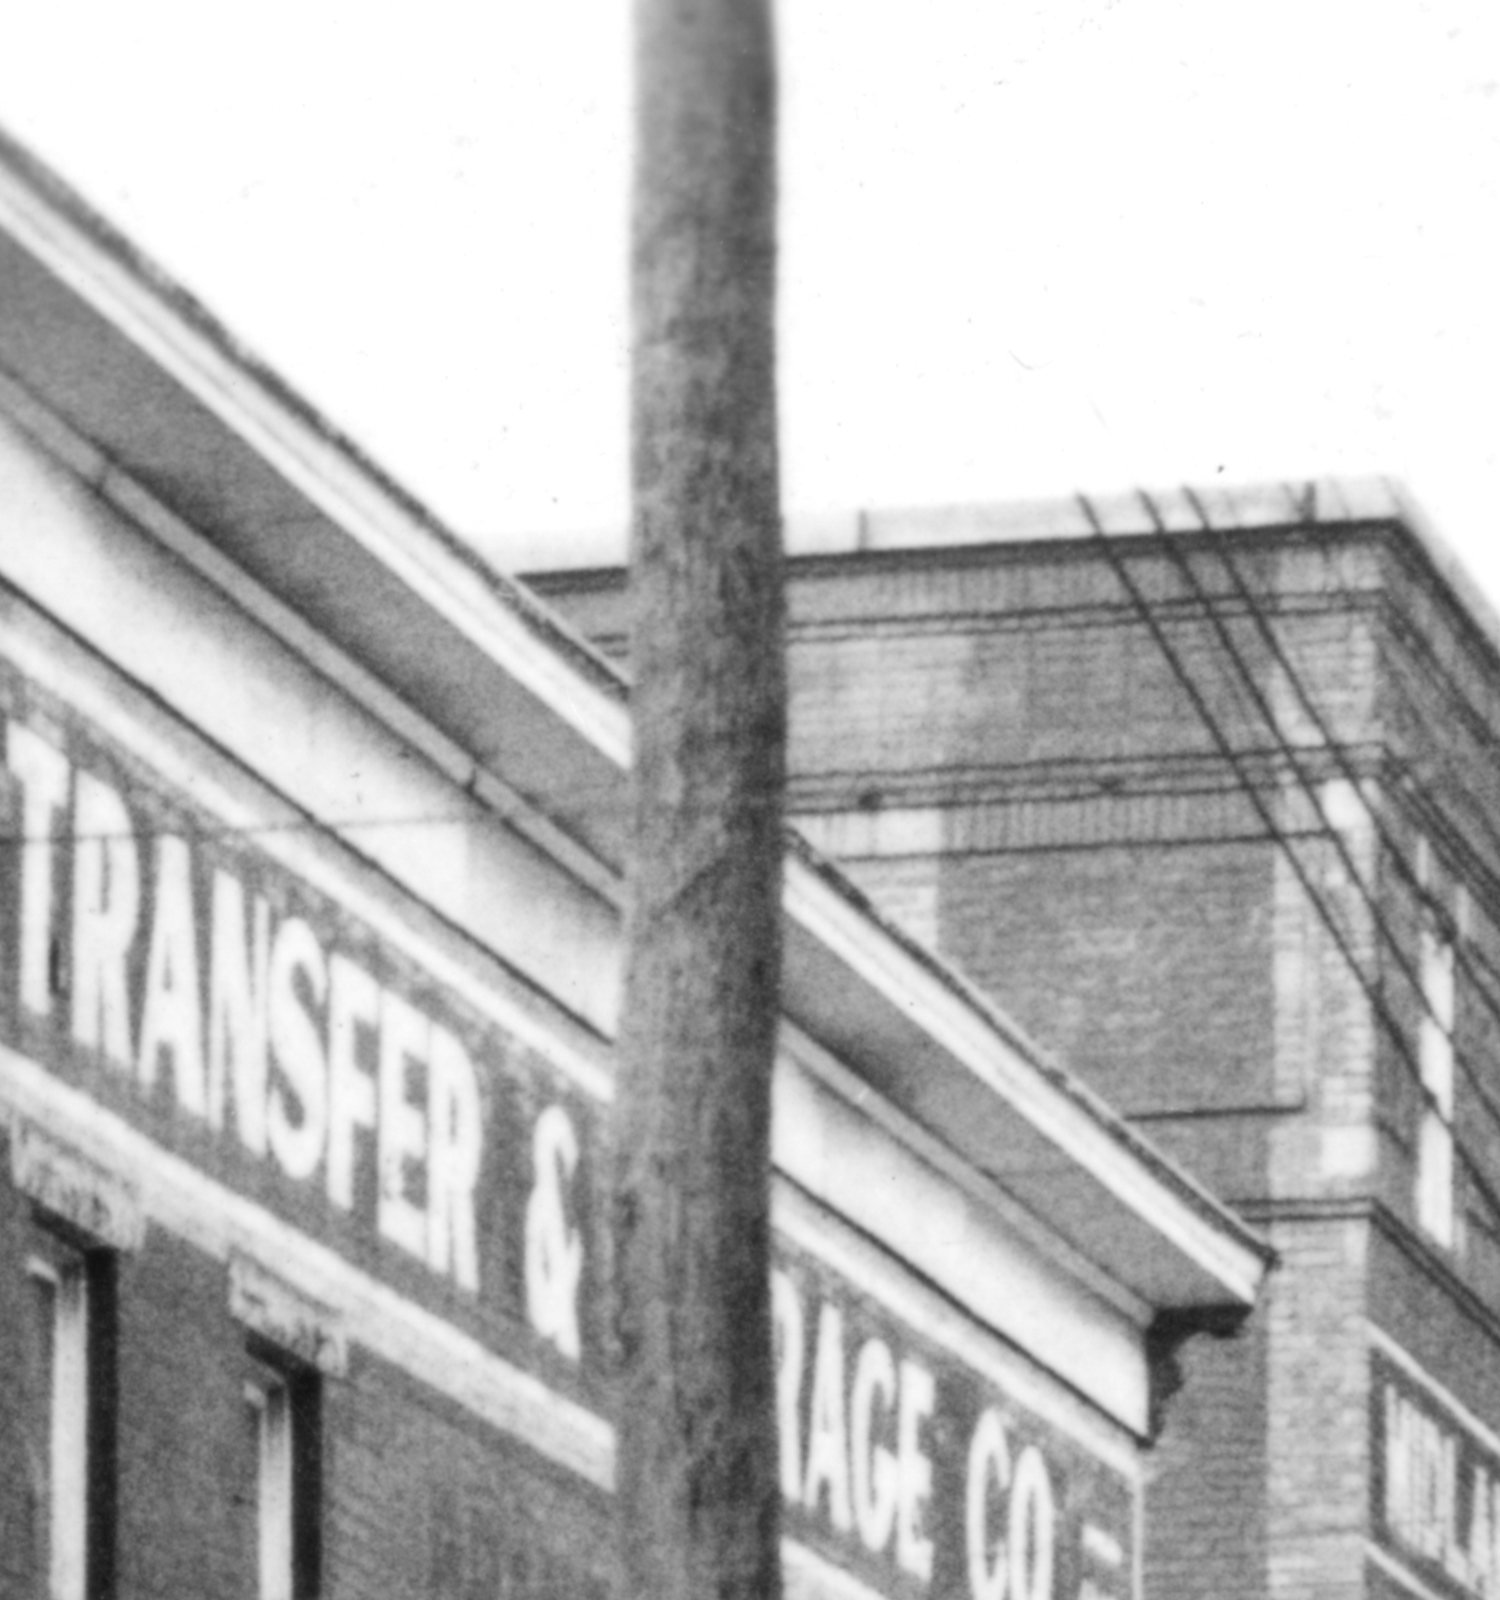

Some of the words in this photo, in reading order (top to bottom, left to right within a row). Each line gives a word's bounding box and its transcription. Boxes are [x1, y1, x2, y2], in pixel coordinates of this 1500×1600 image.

[6, 719, 482, 1293] TRANSFER
[523, 1104, 584, 1360] &
[771, 1267, 936, 1582] RAGE
